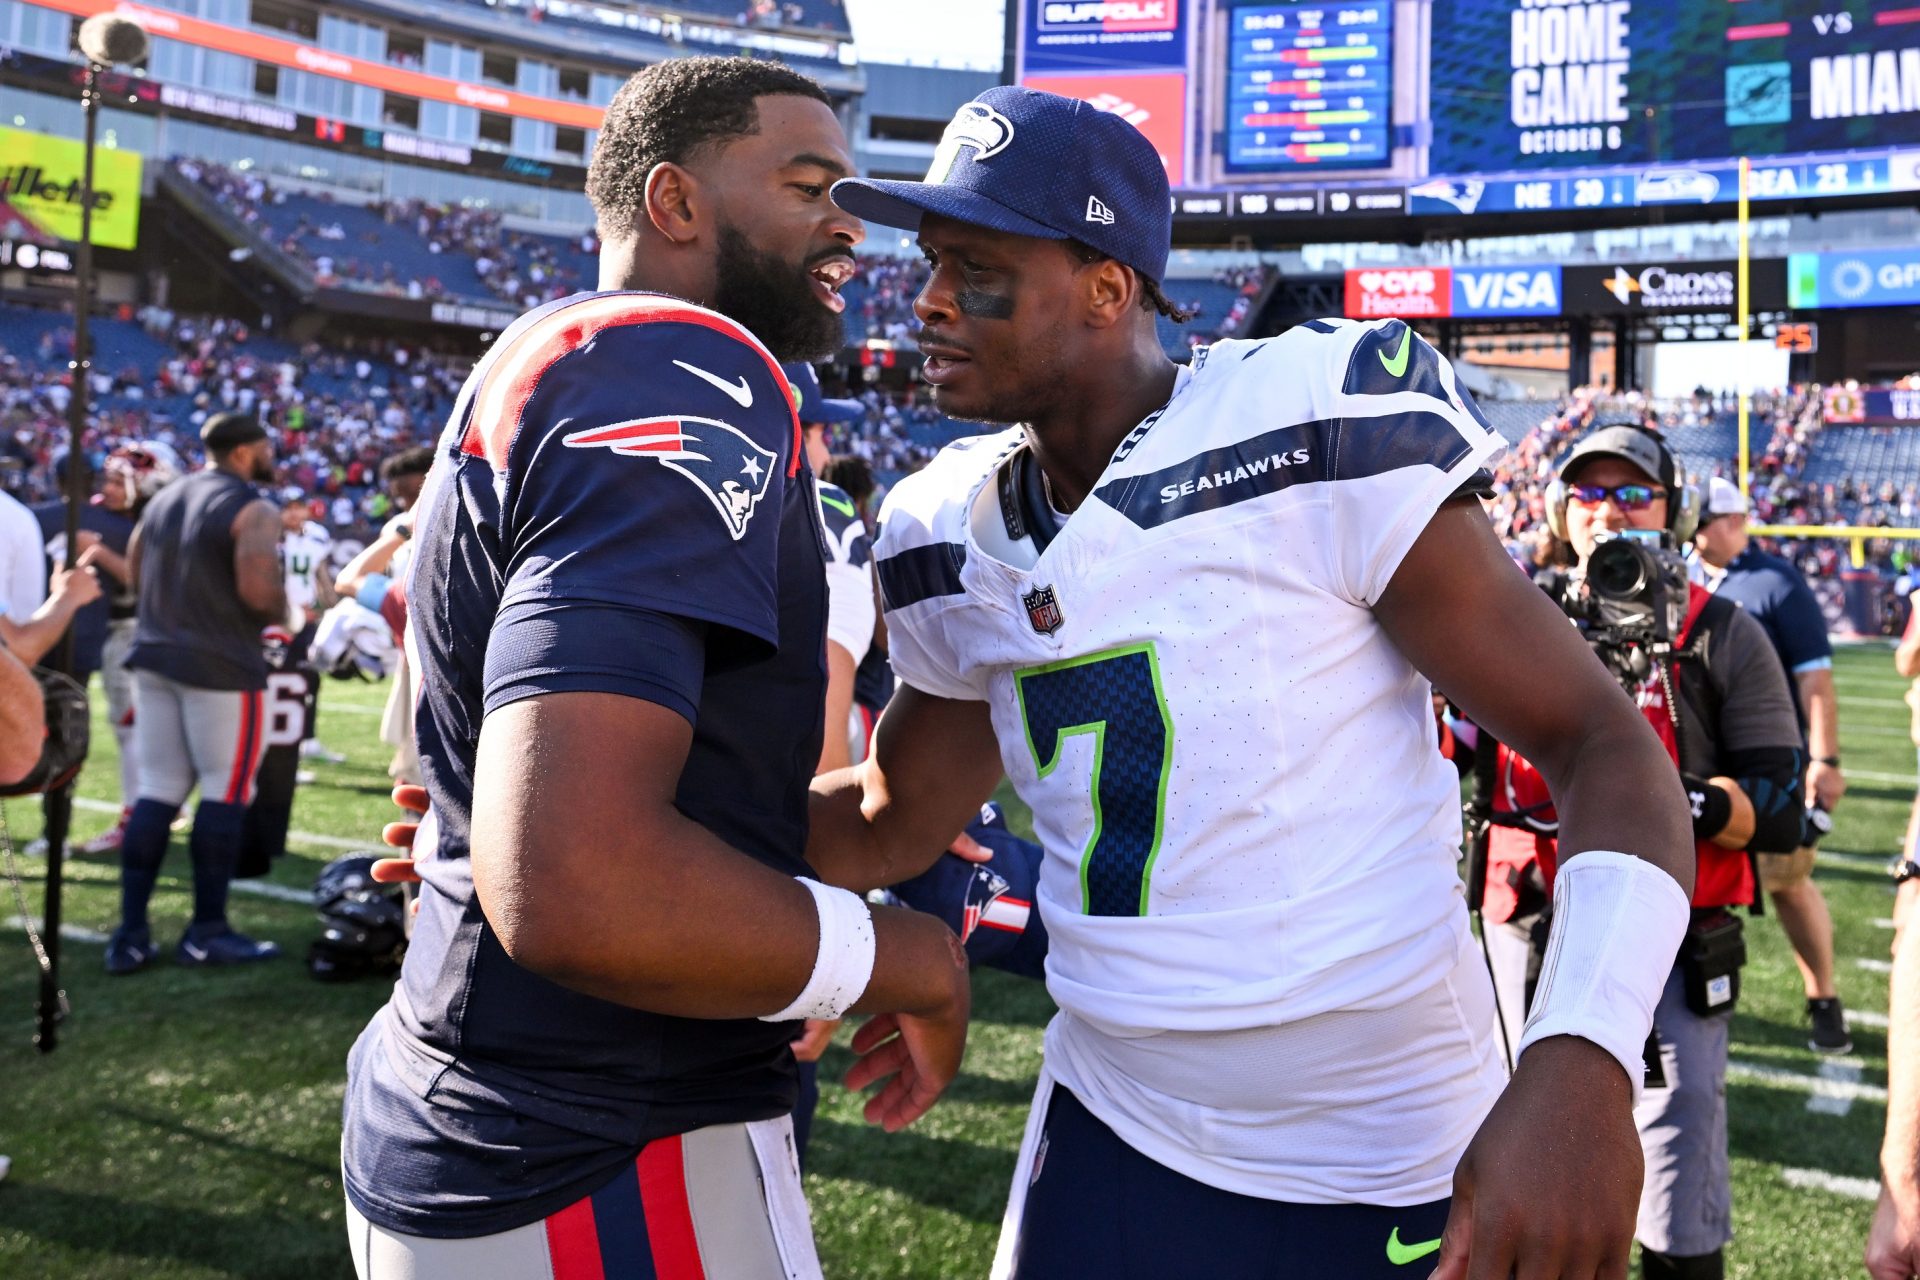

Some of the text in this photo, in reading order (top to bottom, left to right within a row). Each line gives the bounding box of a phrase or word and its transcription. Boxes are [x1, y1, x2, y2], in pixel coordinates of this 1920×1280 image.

[1511, 1, 1631, 68] HOME
[1511, 61, 1630, 127] GAME
[1520, 125, 1622, 155] OCTOBER 6
[1514, 178, 1604, 209] NE 20
[1383, 270, 1435, 295] CVS
[1455, 270, 1557, 309] VISA
[1775, 323, 1812, 352] 25
[1160, 448, 1310, 504] SEAHAWKS
[1013, 639, 1175, 917] 7
